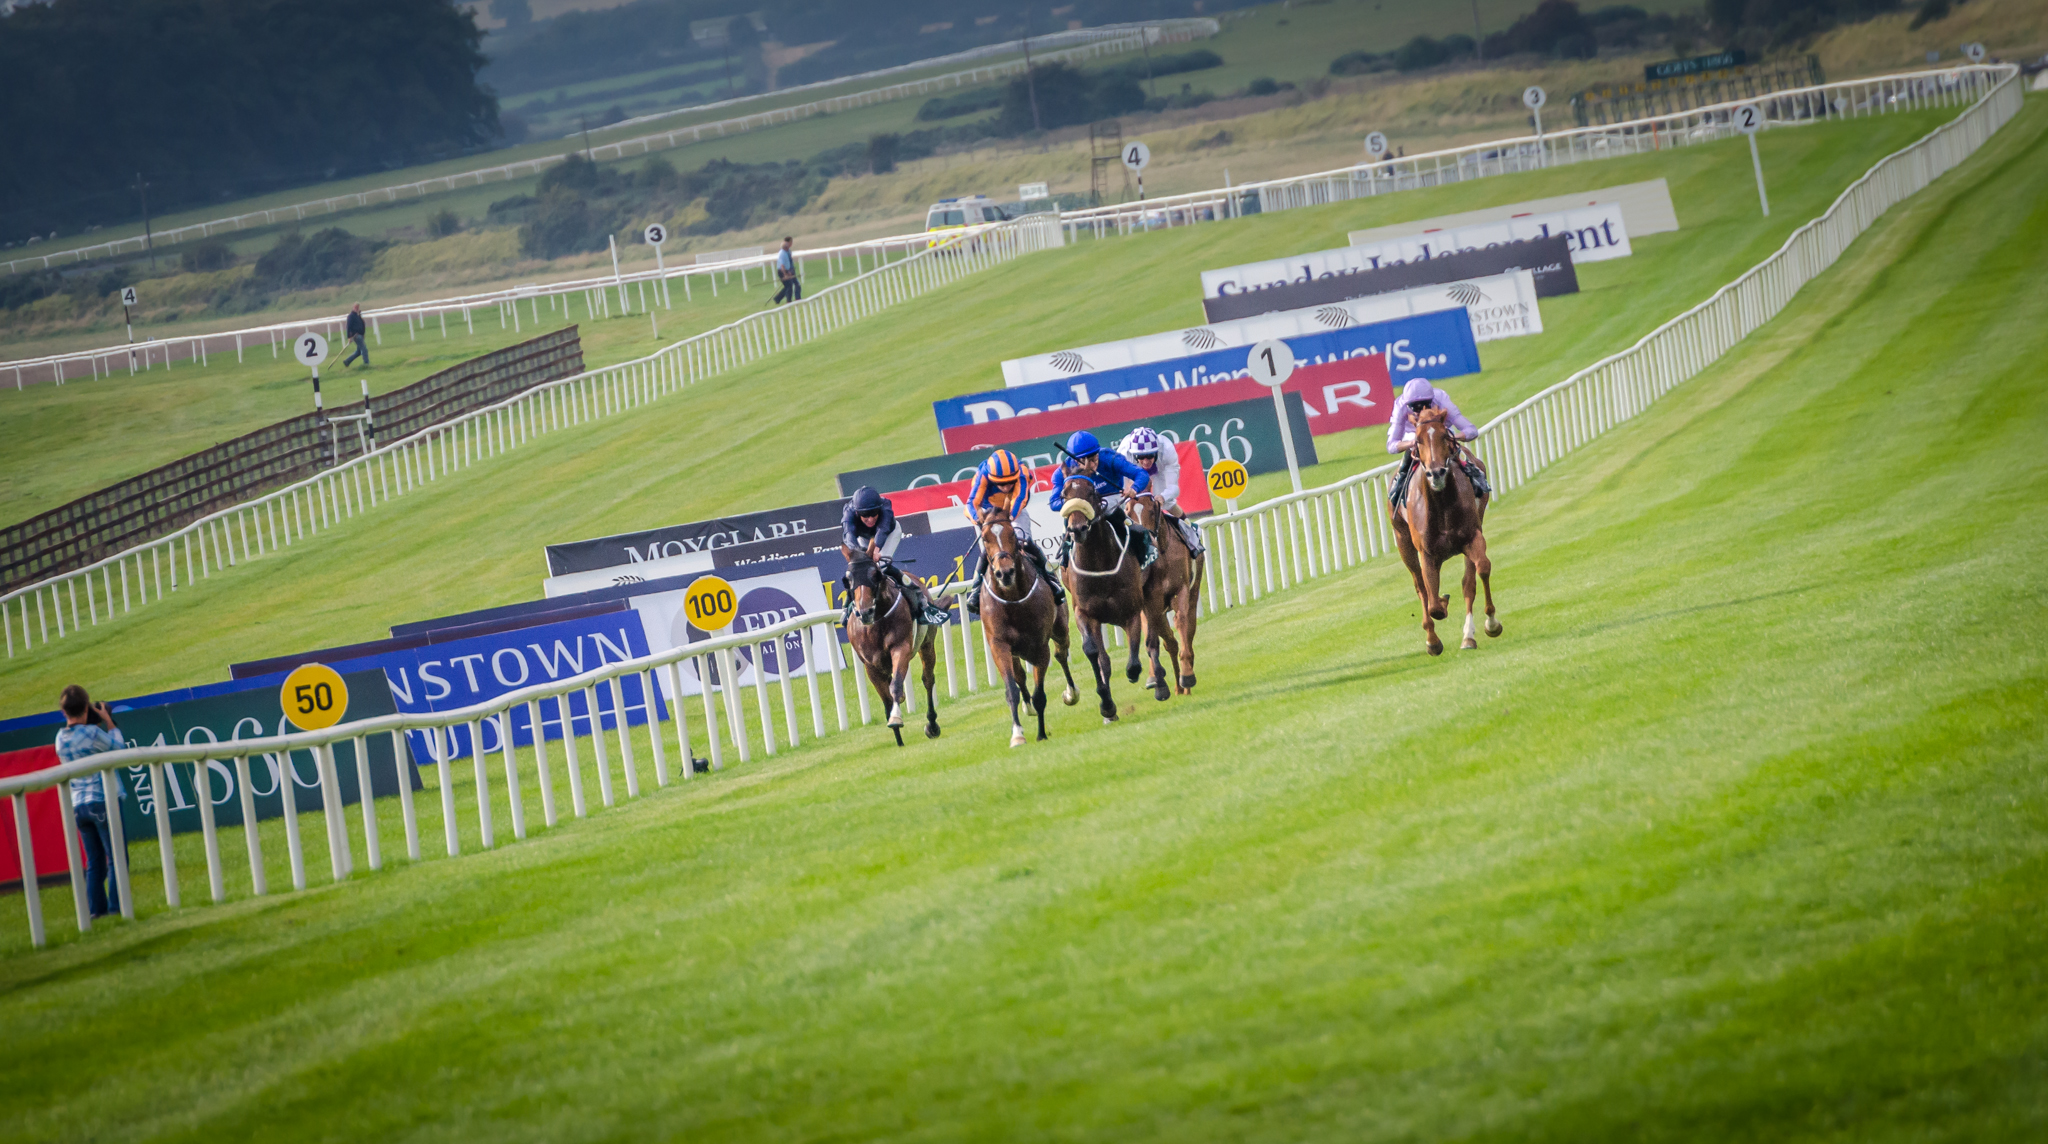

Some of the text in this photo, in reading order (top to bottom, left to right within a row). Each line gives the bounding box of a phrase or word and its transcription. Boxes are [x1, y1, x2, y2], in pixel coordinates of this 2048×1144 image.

[1530, 89, 1539, 104] 3
[1741, 107, 1755, 128] 2
[1370, 135, 1382, 152] 5
[1128, 147, 1142, 165] 4
[649, 227, 663, 242] 3
[124, 288, 135, 302] 4
[1477, 316, 1530, 337] ESTATE
[304, 338, 318, 357] 2
[1261, 347, 1276, 377] 1
[1211, 469, 1245, 491] 200
[689, 589, 733, 619] 100
[295, 682, 334, 714] 50
